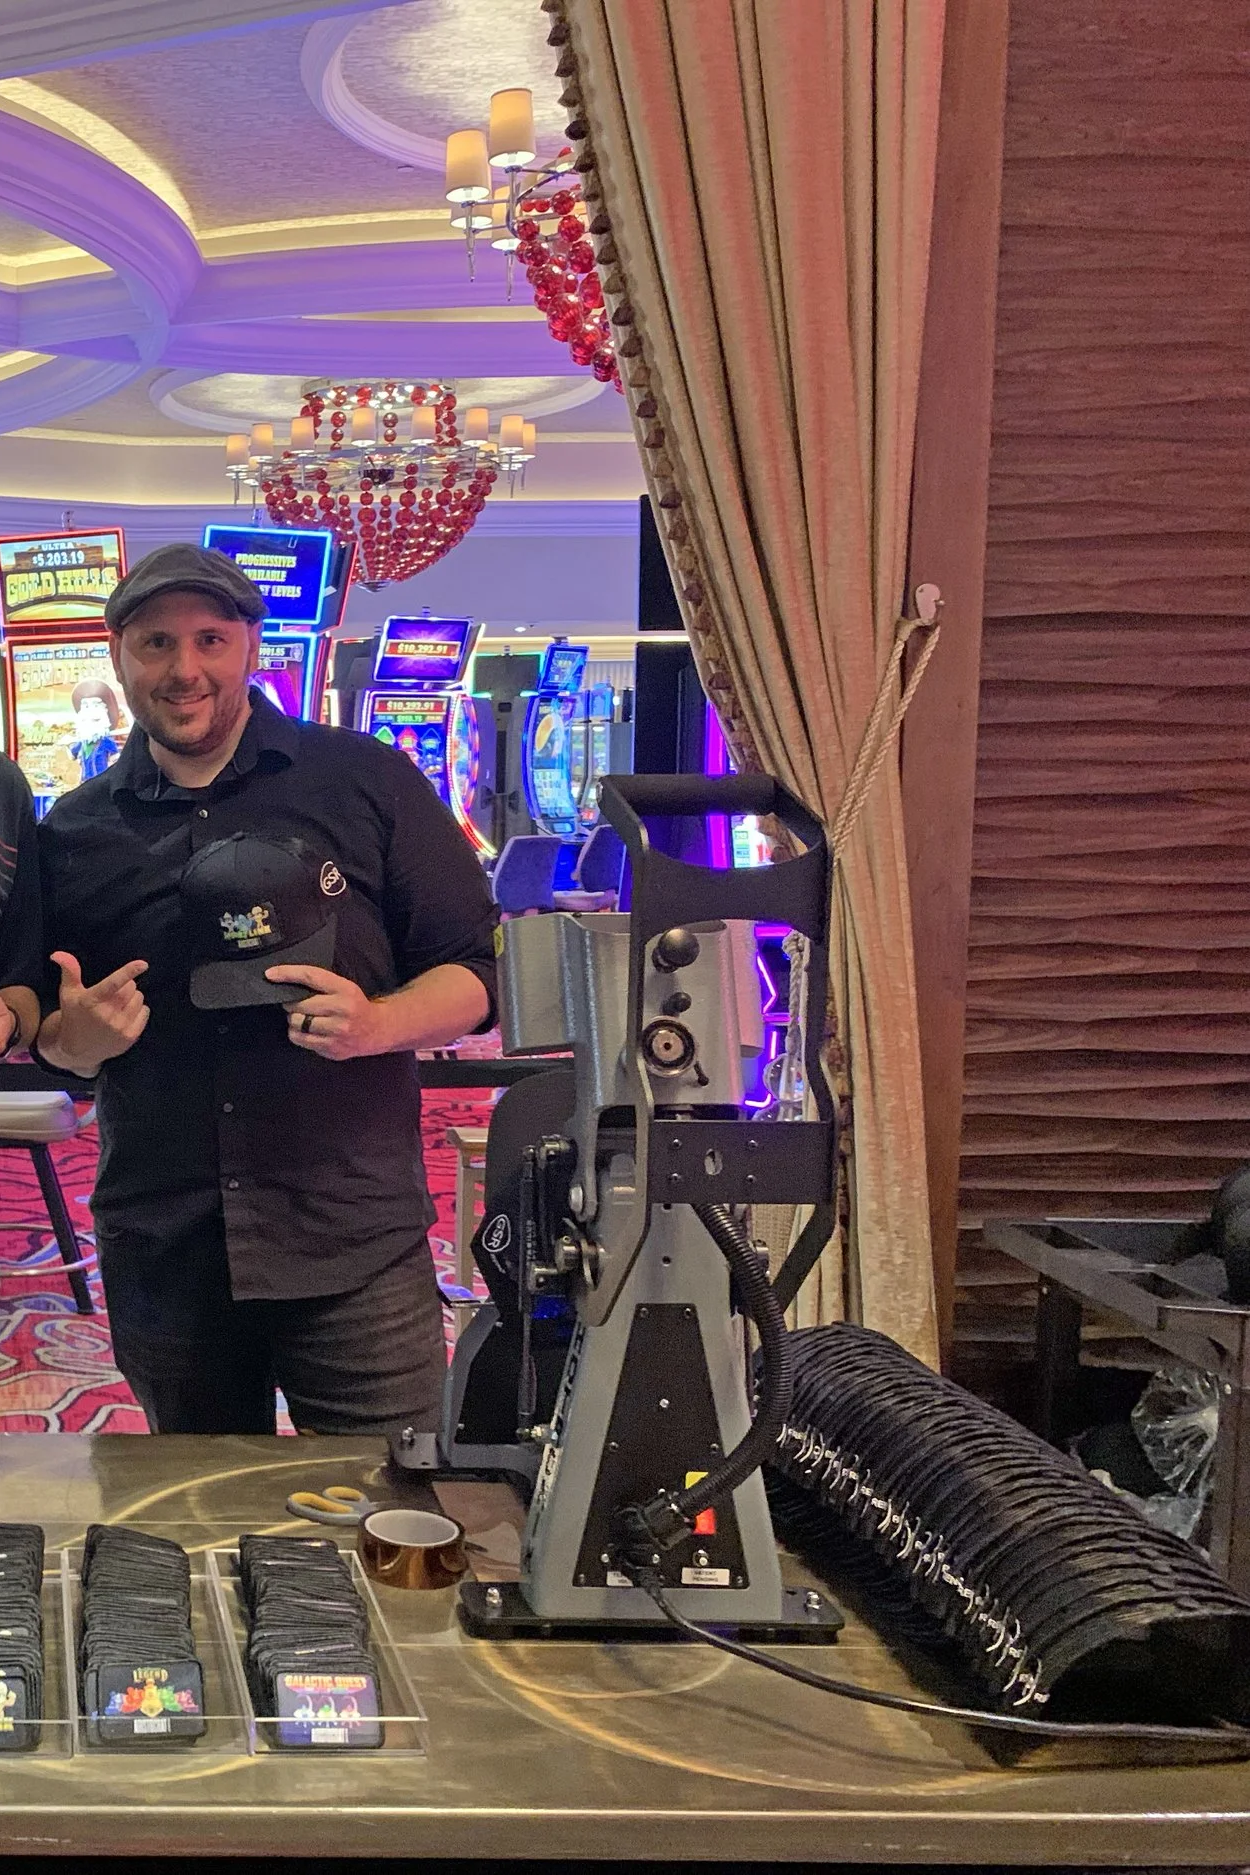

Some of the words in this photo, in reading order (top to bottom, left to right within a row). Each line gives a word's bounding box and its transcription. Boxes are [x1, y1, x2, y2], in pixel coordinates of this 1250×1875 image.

[41, 541, 75, 551] ULTRA
[235, 553, 297, 568] PROGRESSIVES
[271, 585, 302, 598] LEVELS
[488, 1218, 506, 1248] GSR
[133, 1667, 169, 1683] LEGEND
[284, 1675, 332, 1688] GALACTIC
[334, 1675, 367, 1688] QUEST
